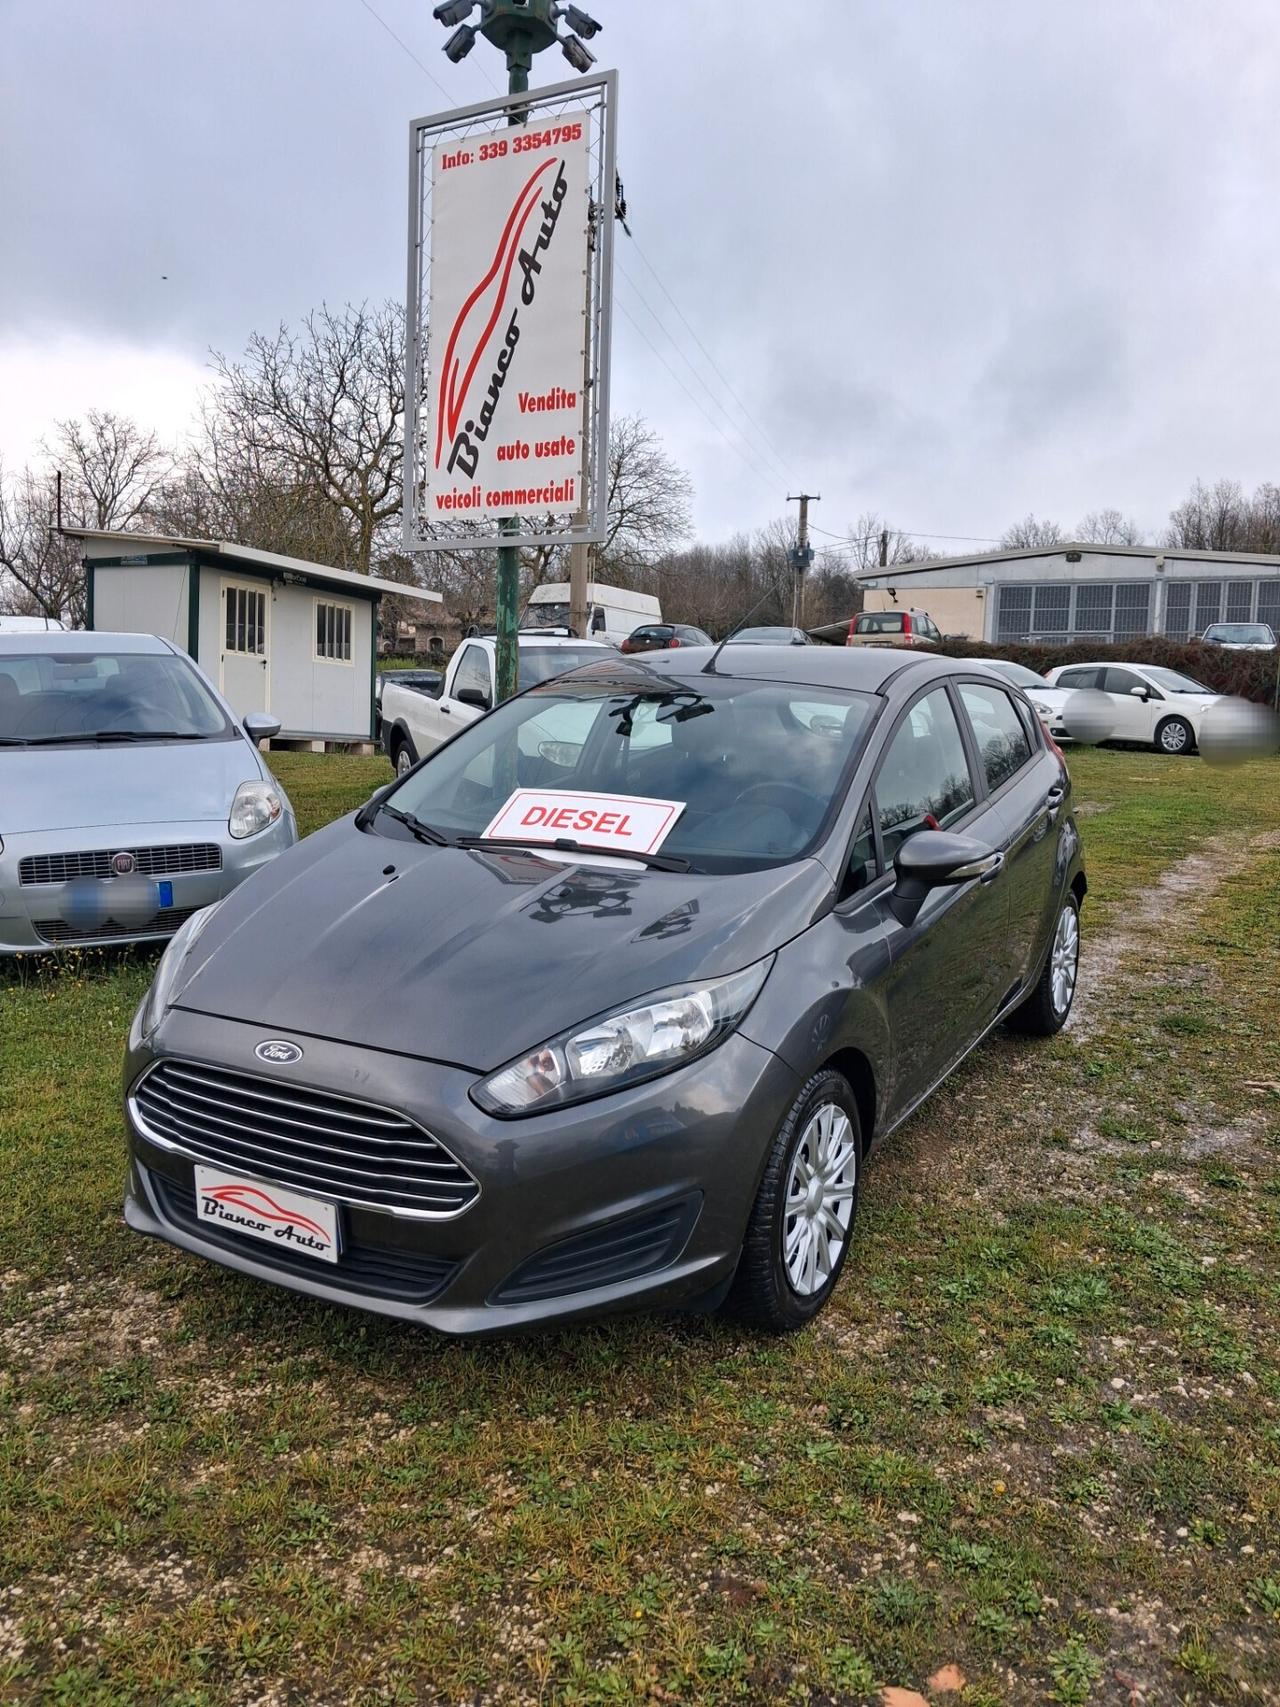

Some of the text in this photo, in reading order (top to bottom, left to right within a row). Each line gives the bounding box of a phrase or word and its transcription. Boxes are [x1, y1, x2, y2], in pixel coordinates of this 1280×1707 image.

[442, 123, 582, 170] Info: 339 3354795
[447, 159, 568, 480] Bianco Auto
[518, 387, 577, 413] Vendita
[496, 435, 576, 461] auto usate
[436, 478, 575, 510] veicoli commerciali
[520, 806, 633, 836] DIESEL
[263, 1044, 292, 1060] Ford
[201, 1196, 331, 1252] Bianco Auto
